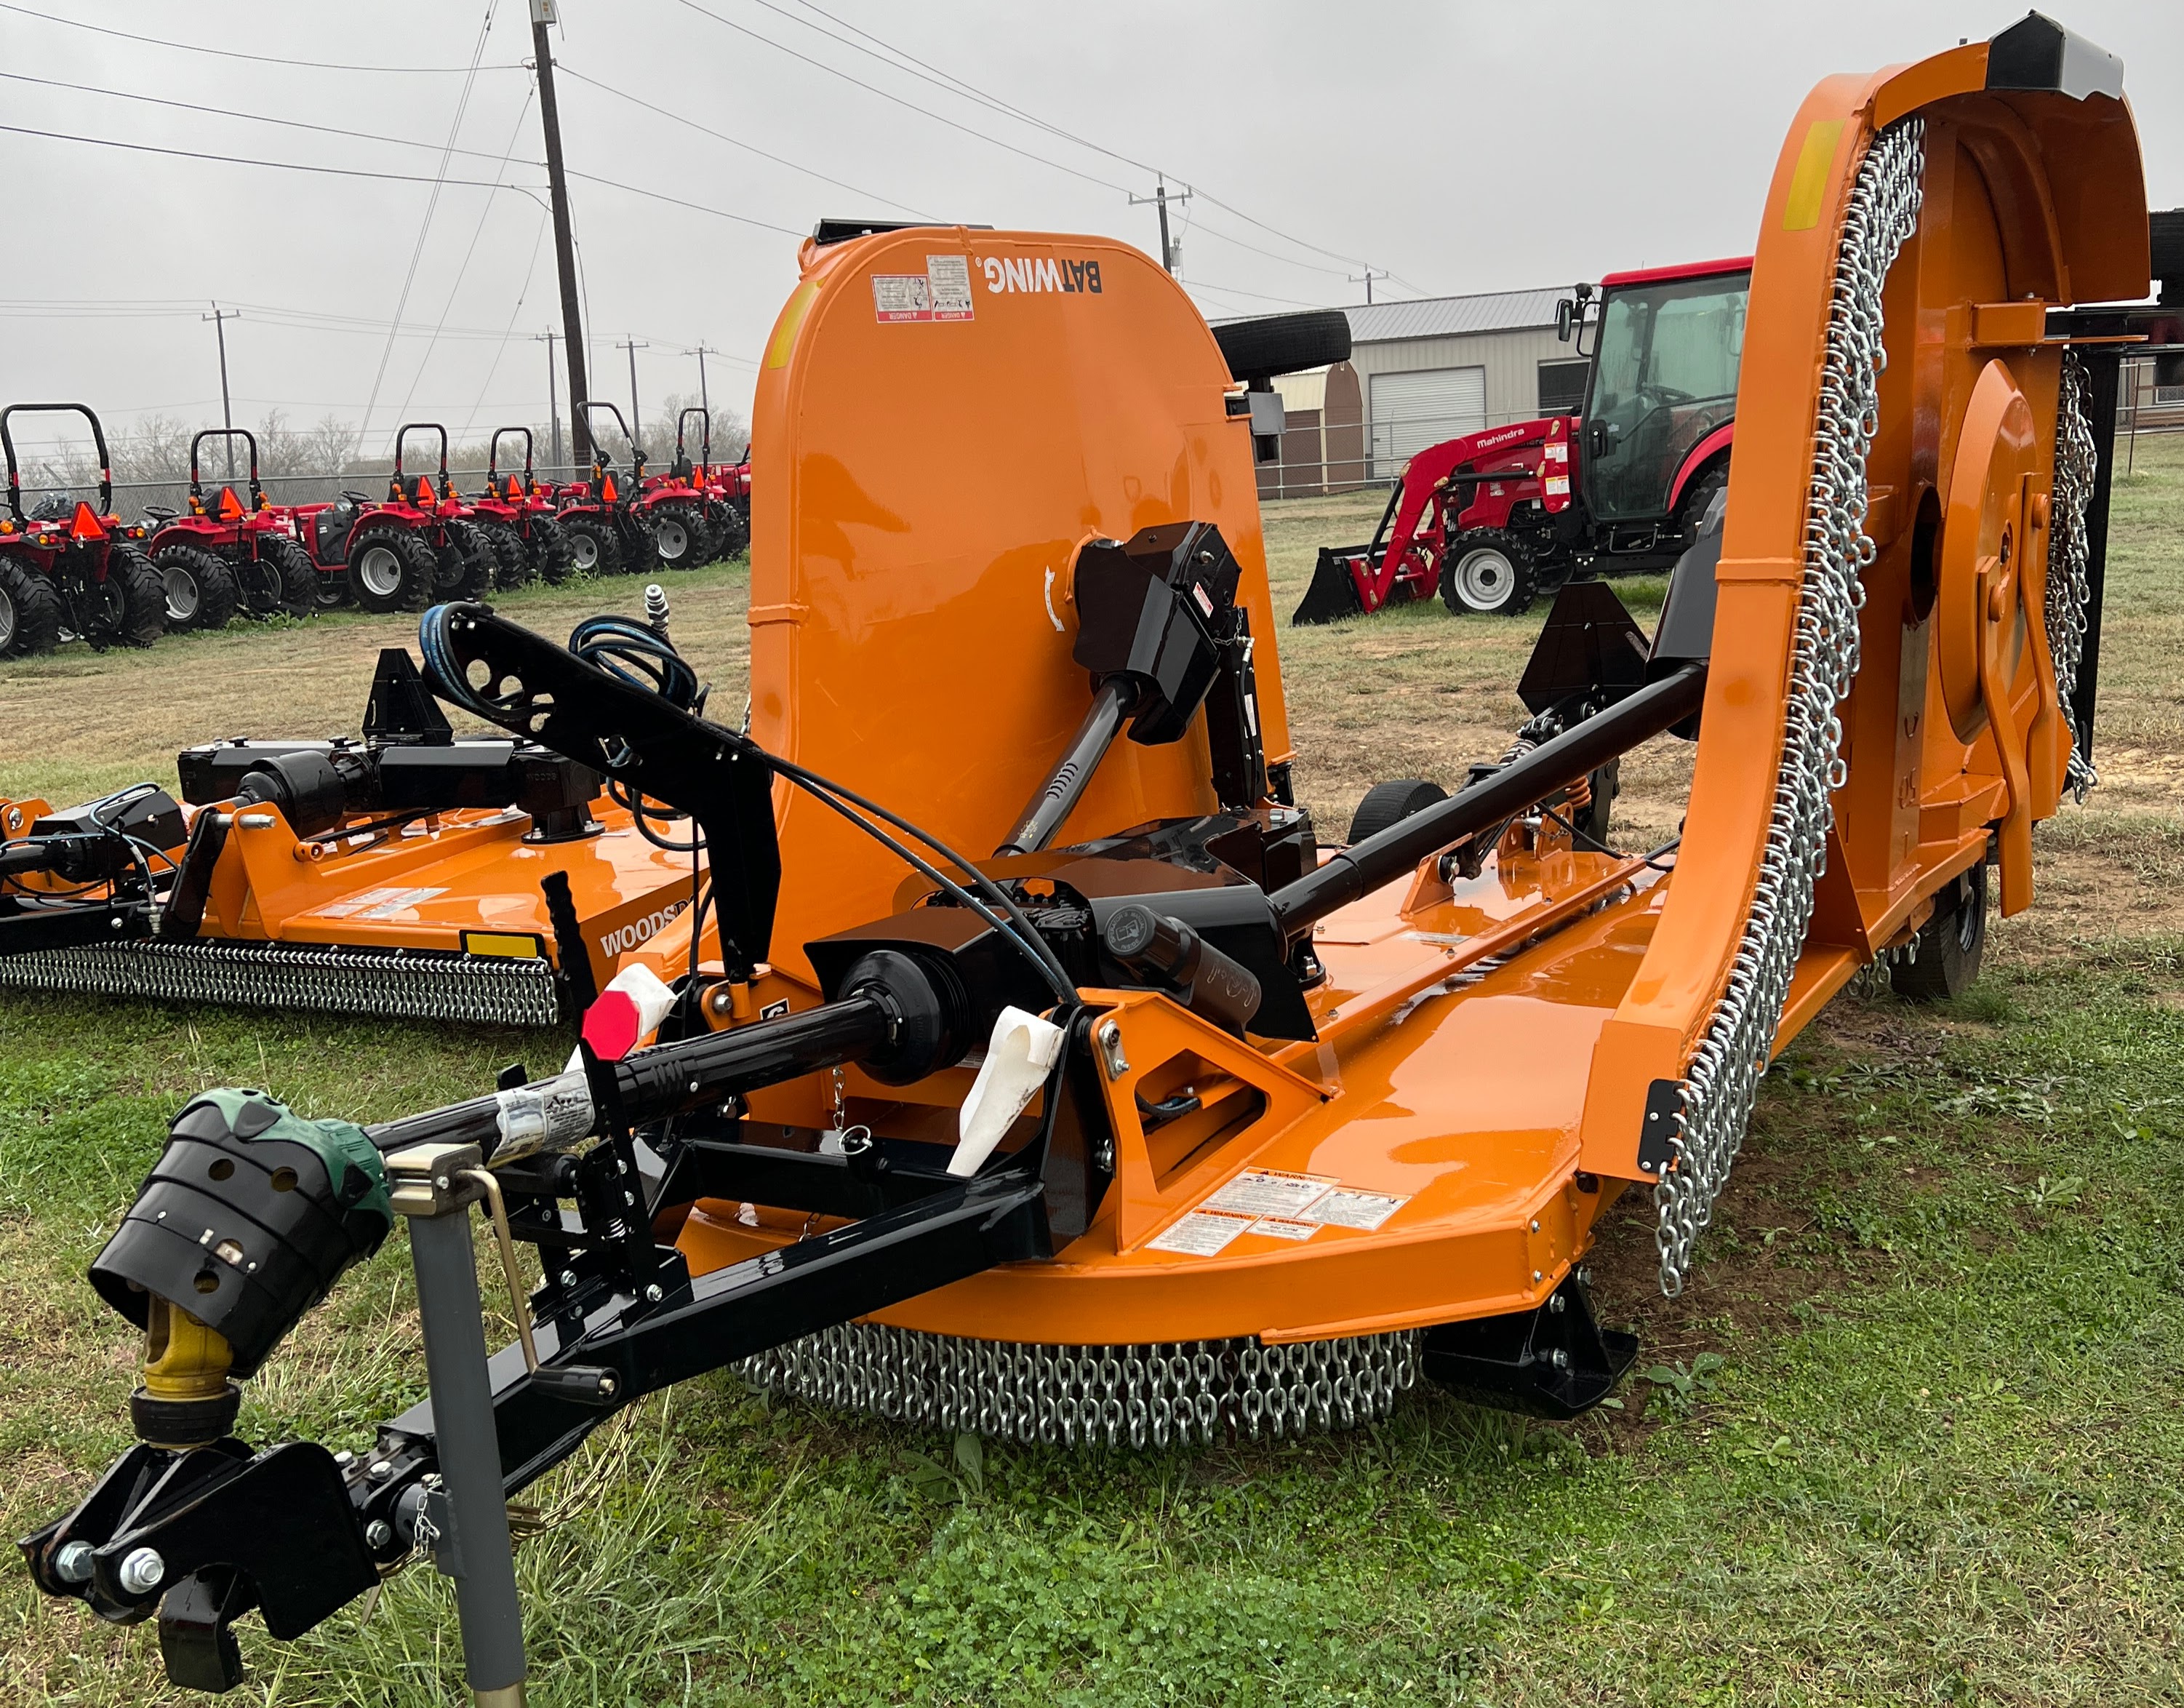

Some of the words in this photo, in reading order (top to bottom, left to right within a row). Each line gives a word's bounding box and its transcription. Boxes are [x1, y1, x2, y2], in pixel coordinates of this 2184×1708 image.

[983, 257, 1103, 294] BATWING
[889, 312, 912, 320] DANGER
[1120, 938, 1140, 949] INSIDE
